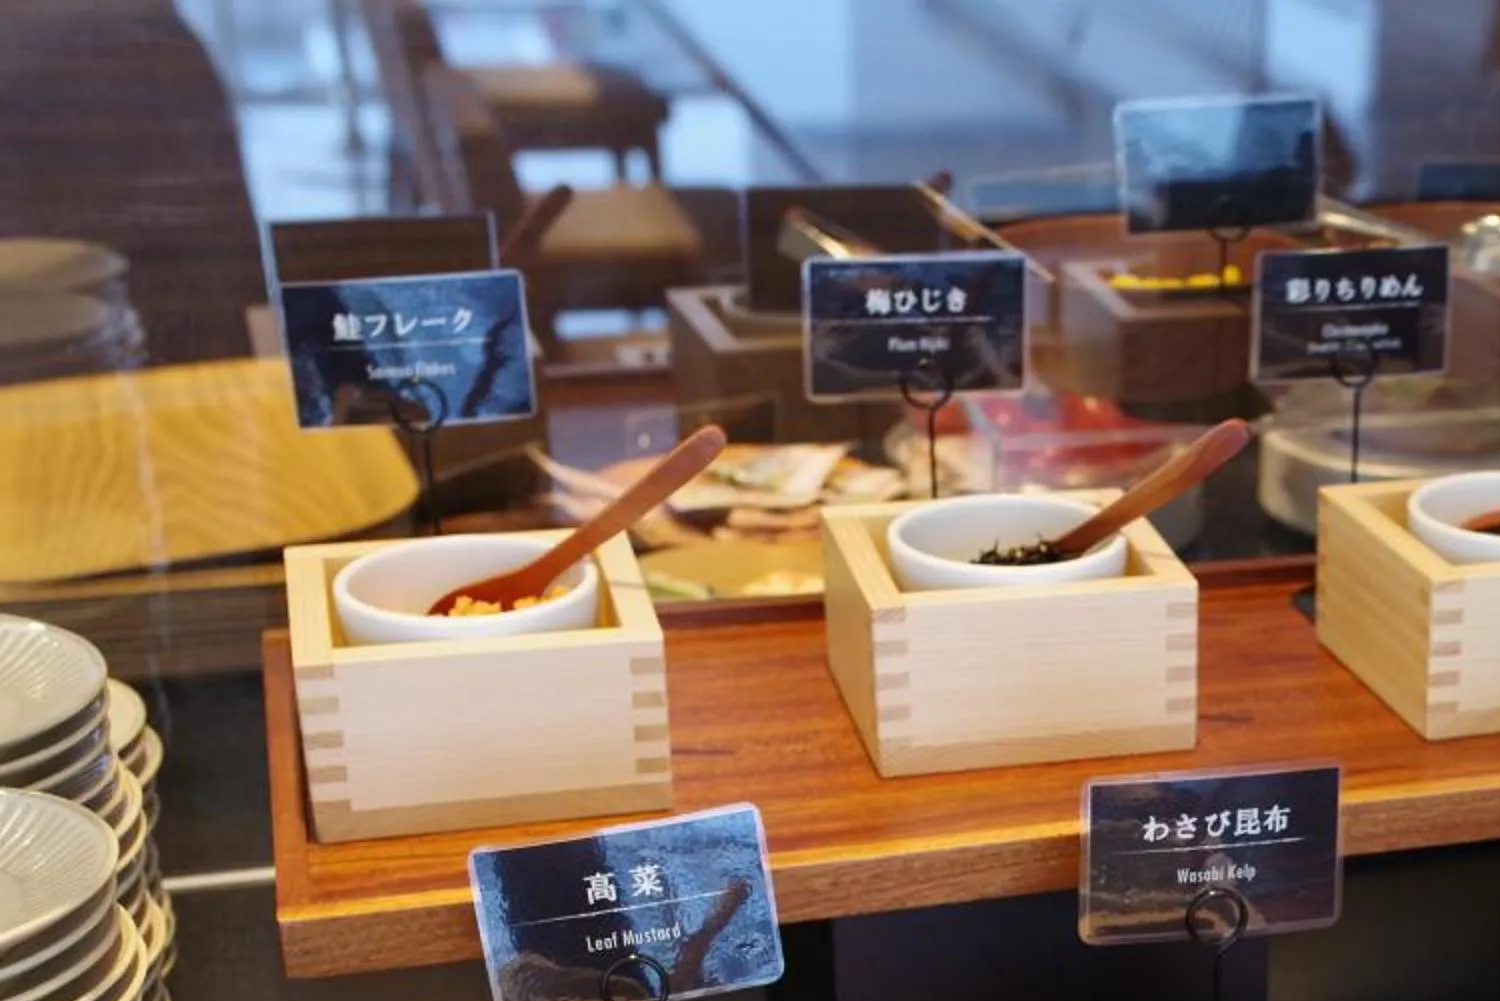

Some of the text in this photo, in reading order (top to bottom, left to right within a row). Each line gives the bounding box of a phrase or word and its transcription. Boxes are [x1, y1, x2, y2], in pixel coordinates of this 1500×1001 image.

[865, 286, 968, 315] 梅ひじき
[1285, 273, 1424, 304] 彩りちりめん
[332, 307, 473, 342] 鮭フレーク
[1142, 804, 1291, 843] わさび昆布
[1176, 863, 1257, 884] Wasabi Kelp
[586, 920, 682, 953] Leaf Mustard
